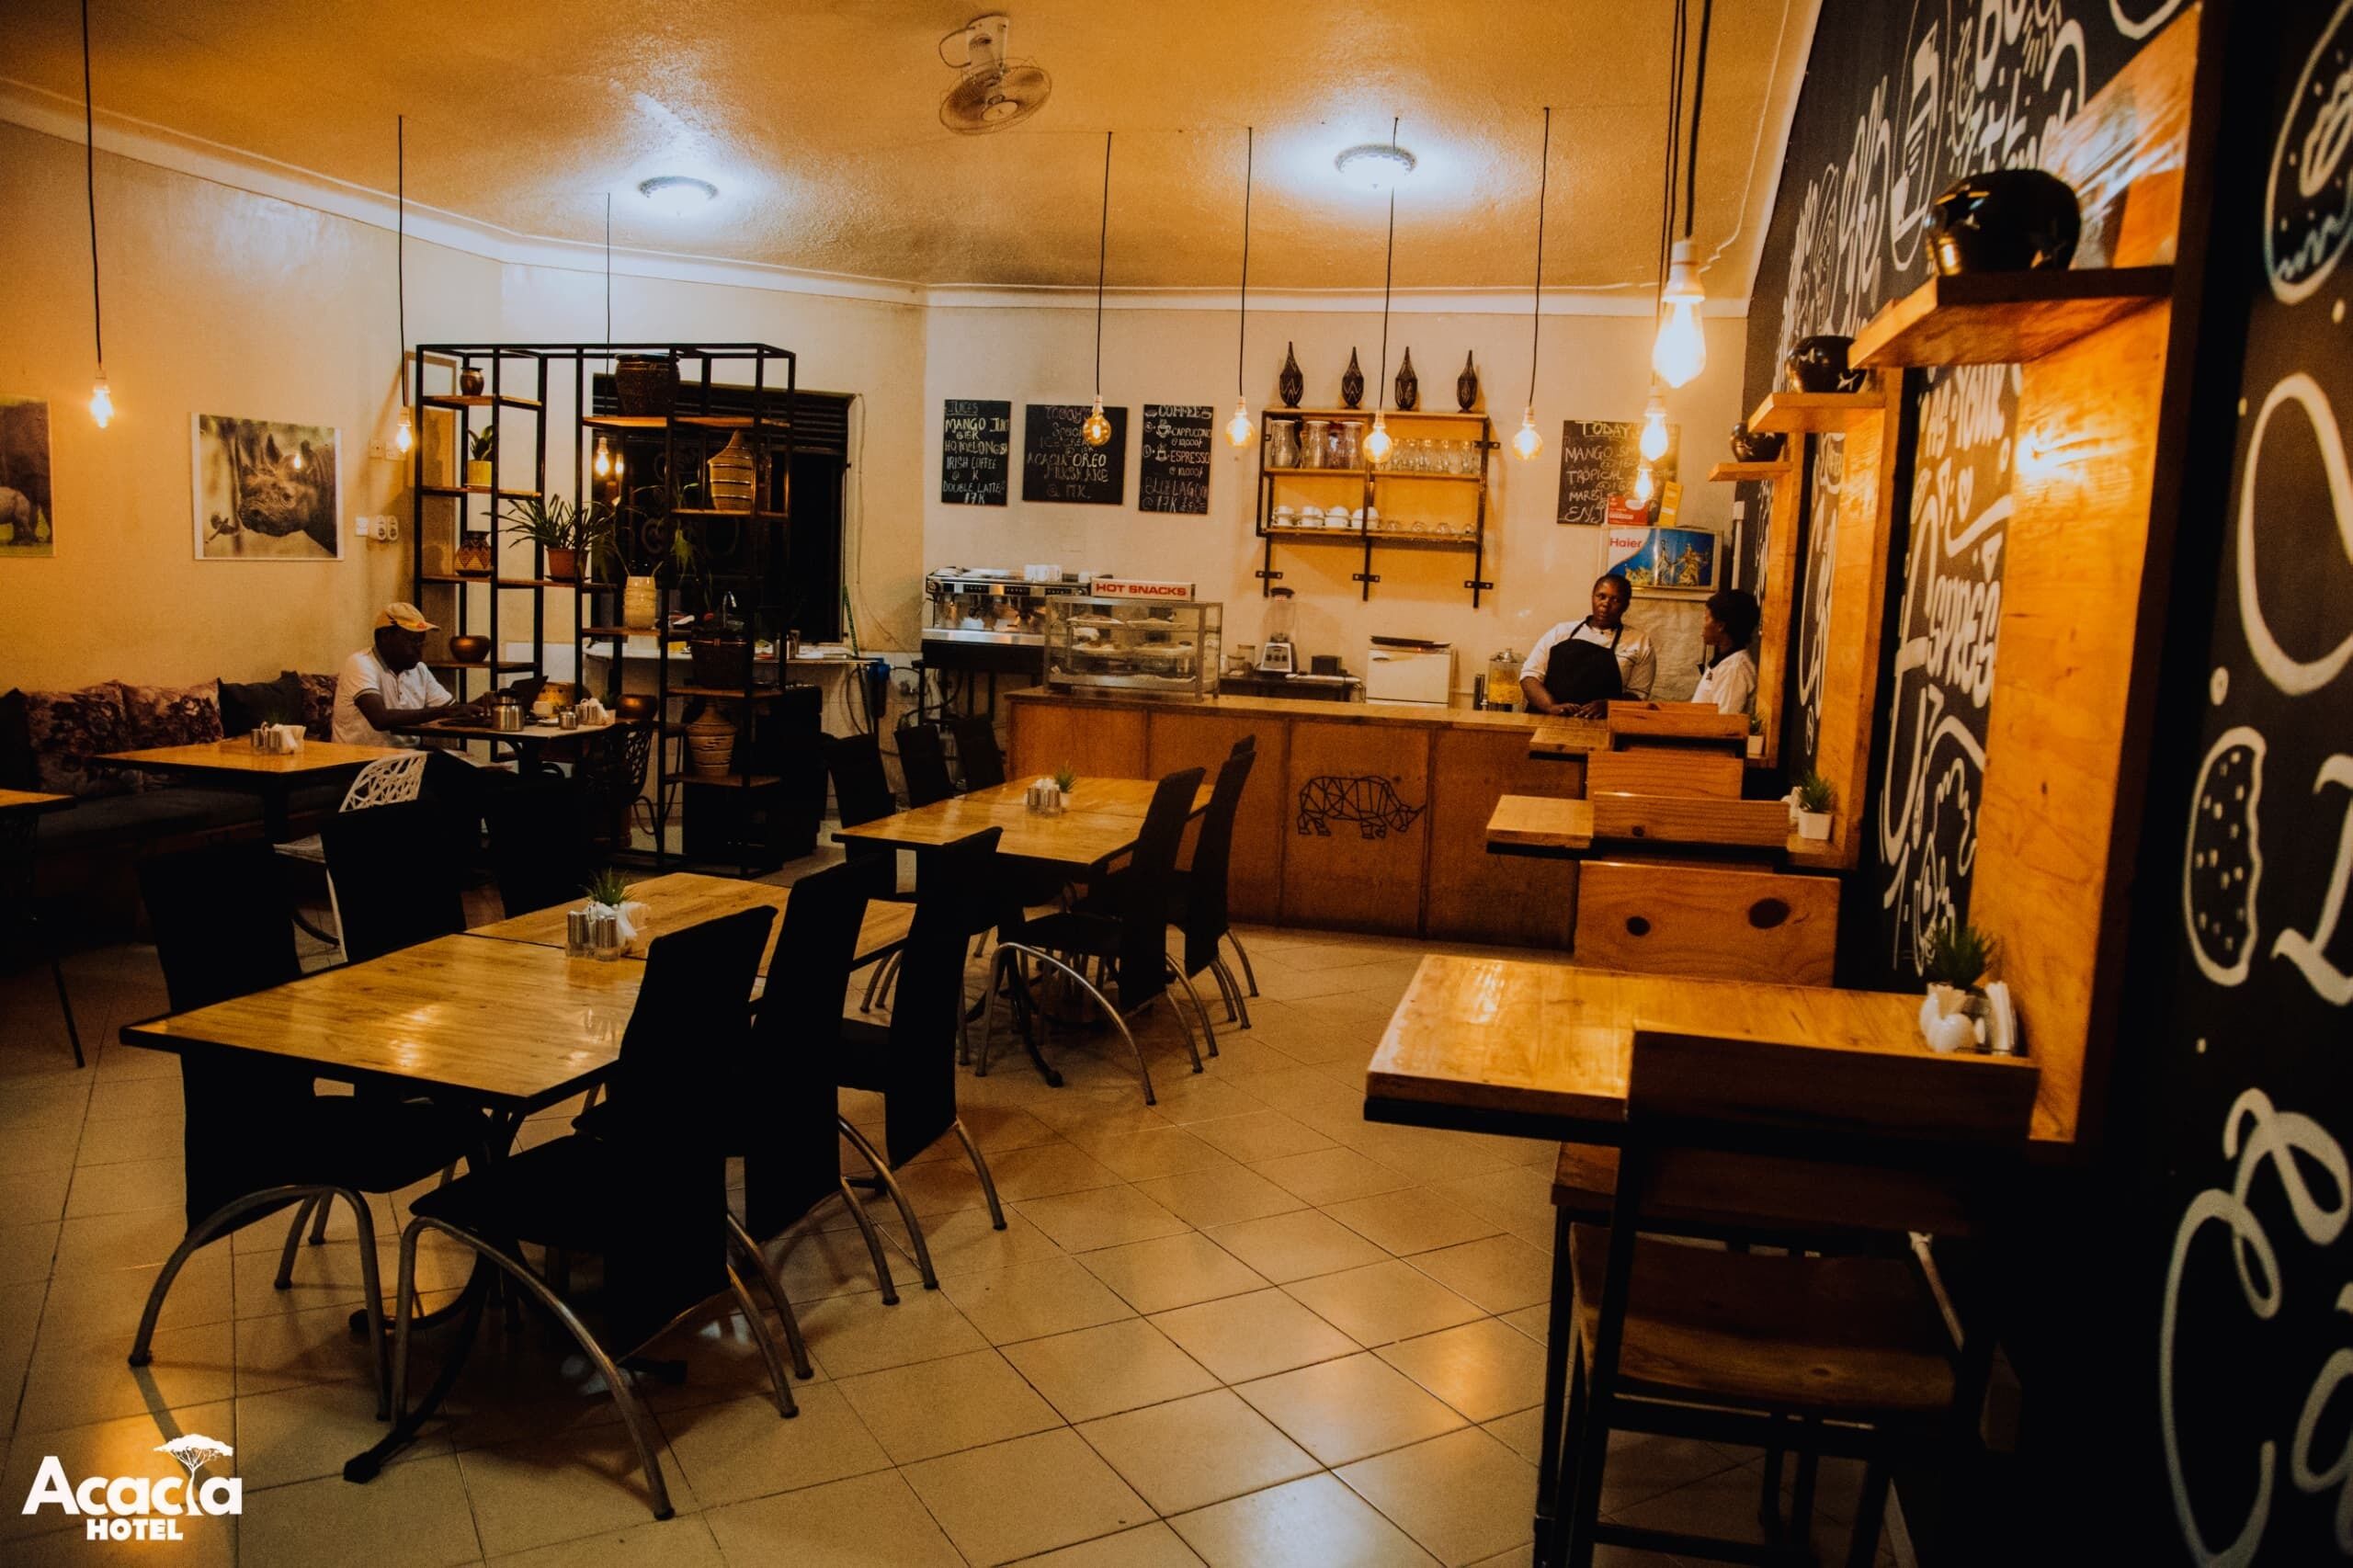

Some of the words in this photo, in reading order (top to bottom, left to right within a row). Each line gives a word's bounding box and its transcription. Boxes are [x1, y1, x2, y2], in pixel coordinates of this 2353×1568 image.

[946, 417, 986, 433] MANGO
[1072, 453, 1107, 468] OREO
[1170, 450, 1211, 463] ESPRESSO
[1564, 446, 1613, 463] MANGO
[1565, 468, 1624, 484] TROPICAL
[1569, 488, 1607, 502] MARBL
[1565, 506, 1604, 523] ENJ
[1609, 537, 1642, 549] Haier
[1096, 583, 1125, 593] HOT
[1129, 585, 1188, 597] SNACKS
